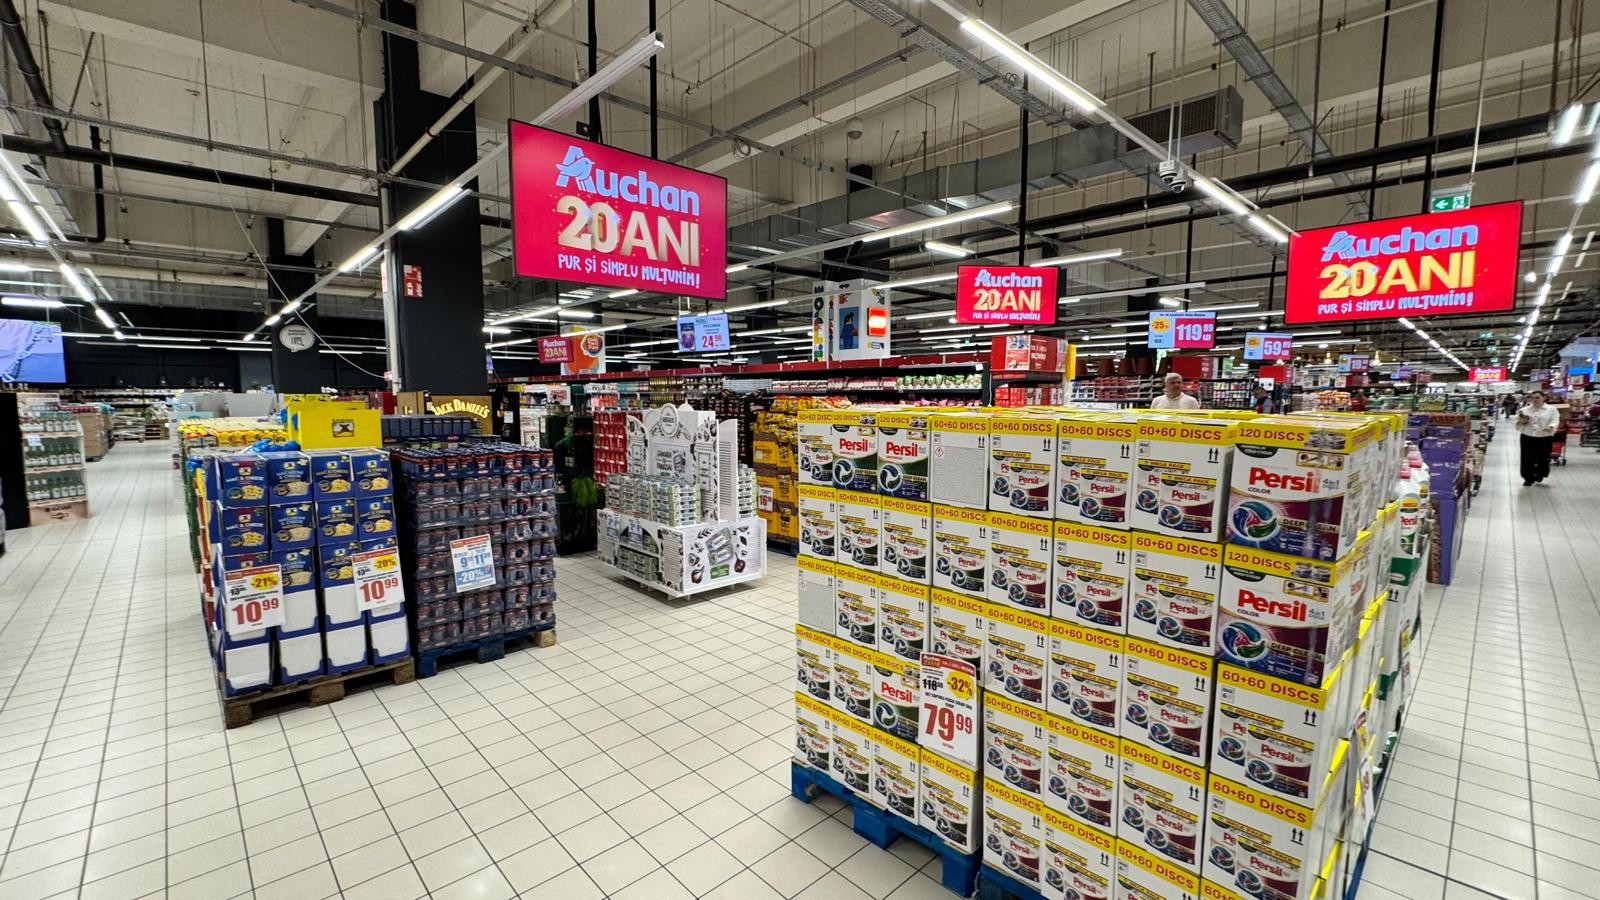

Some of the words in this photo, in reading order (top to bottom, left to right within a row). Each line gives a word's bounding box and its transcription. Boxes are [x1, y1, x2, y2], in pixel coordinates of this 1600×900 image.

[556, 145, 699, 216] Auchan
[556, 195, 620, 254] 20
[620, 210, 700, 267] ANI
[1321, 224, 1478, 262] Auchan
[558, 254, 581, 270] PUR
[974, 269, 1042, 287] Auchan
[1319, 261, 1378, 299] 20
[1377, 251, 1476, 295] ANI
[1318, 303, 1338, 315] PUR
[1176, 324, 1202, 341] 119
[1264, 341, 1281, 355] 59
[934, 421, 957, 429] 60+60
[960, 423, 986, 431] DISCS
[992, 423, 1019, 431] 60+60
[1022, 423, 1052, 432] DISCS
[1061, 426, 1093, 435] 60+60
[1096, 428, 1132, 438] DISCS
[1139, 427, 1176, 437] 60+60
[1180, 429, 1221, 440] DISCS
[1239, 428, 1260, 438] 120
[1264, 431, 1304, 442] DISCS
[840, 438, 868, 451] Persil
[886, 442, 918, 456] Persil
[1019, 476, 1040, 484] Persil
[1091, 483, 1115, 493] Persil
[839, 494, 858, 502] 60+60
[859, 497, 879, 505] DISCS
[1172, 490, 1200, 501] Persil
[1248, 487, 1271, 495] COLOR
[884, 500, 904, 509] 60+60
[905, 503, 928, 513] DISCS
[935, 507, 959, 517] 60+60
[961, 511, 987, 521] DISCS
[991, 517, 1018, 527] 60+60
[1020, 521, 1049, 532] DISCS
[1283, 518, 1305, 527] DEEP
[1057, 526, 1088, 538] 60+60
[1092, 531, 1127, 545] DISCS
[1136, 537, 1172, 550] 60+60
[1177, 543, 1218, 558] DISCS
[1227, 551, 1248, 562] 120
[1252, 556, 1291, 571] DISCS
[458, 569, 485, 583] -20%
[837, 568, 856, 580] 60+60
[857, 573, 876, 584] DISCS
[360, 580, 385, 603] 10
[384, 577, 398, 589] 99
[880, 579, 901, 590] 60+60
[902, 585, 925, 596] DISCS
[1087, 586, 1111, 597] Persil
[232, 601, 262, 625] 10
[262, 597, 279, 611] 99
[933, 592, 956, 605] 60+60
[958, 600, 984, 613] DISCS
[1170, 602, 1199, 615] Persil
[1238, 589, 1307, 622] Persil
[988, 608, 1014, 621] 60+60
[1017, 616, 1046, 630] DISCS
[1237, 608, 1259, 618] COLOR
[1051, 624, 1082, 638] 60+60
[1086, 632, 1120, 649] DISCS
[1128, 642, 1164, 659] 60+60
[1167, 652, 1207, 671] DISCS
[881, 682, 912, 703] Persil
[946, 676, 972, 697] -32%
[1080, 685, 1104, 698] Persil
[1222, 670, 1266, 689] 60+60
[1271, 683, 1320, 704] DISCS
[986, 696, 1012, 712] 60+60
[1015, 705, 1044, 722] DISCS
[1161, 709, 1189, 724] Persil
[924, 702, 955, 742] 79
[956, 713, 973, 735] 99
[1082, 729, 1115, 750] DISCS
[1261, 743, 1296, 762] Persil
[1123, 745, 1158, 765] 60+60
[1162, 759, 1201, 781] DISCS
[985, 782, 1010, 799] 60+60
[1012, 792, 1041, 812] DISCS
[1076, 783, 1101, 797] Persil
[1212, 781, 1255, 804] 60+60
[1259, 798, 1306, 823] DISCS
[1045, 813, 1075, 832] 60+60
[1077, 827, 1110, 848] DISCS
[1157, 815, 1183, 832] Persil
[1118, 846, 1152, 869] 60+60
[1156, 862, 1194, 889] DISCS
[1250, 856, 1283, 876] Persil
